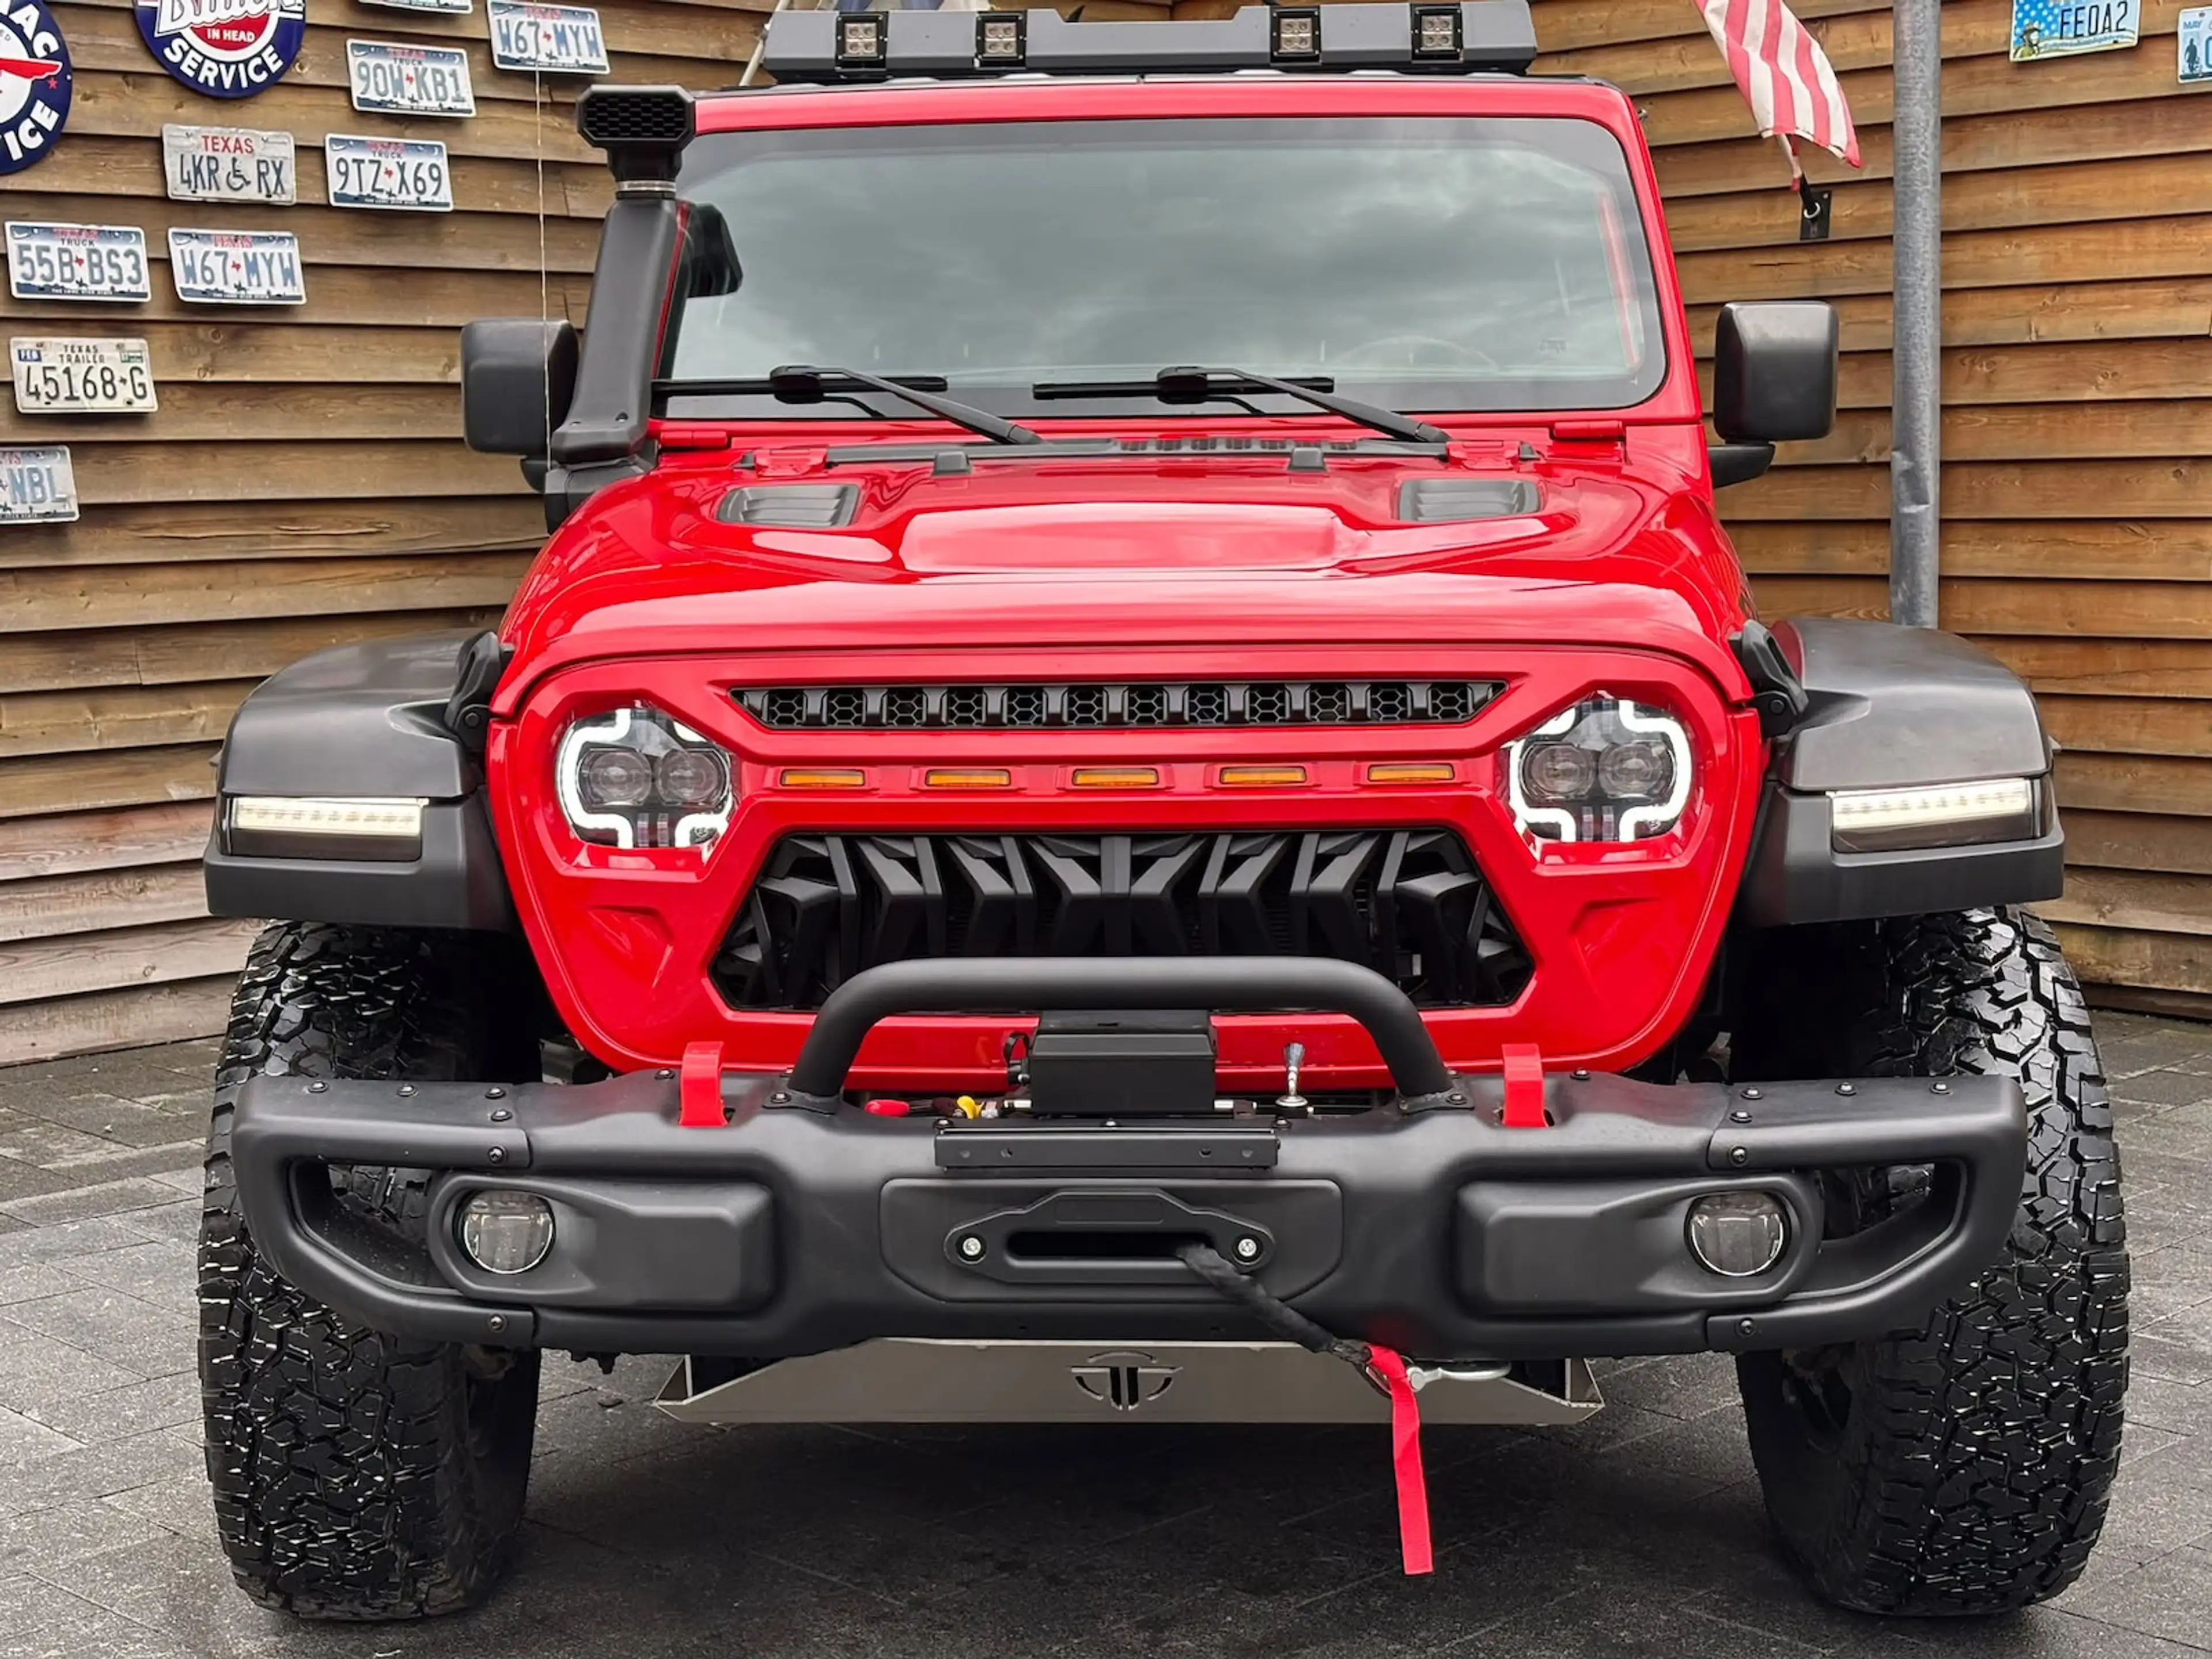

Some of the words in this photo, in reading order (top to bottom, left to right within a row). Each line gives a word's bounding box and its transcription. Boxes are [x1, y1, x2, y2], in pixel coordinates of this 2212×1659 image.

[207, 28, 219, 39] IN
[223, 30, 255, 43] HEAD
[497, 19, 540, 55] W67
[554, 24, 601, 57] MYW
[163, 38, 283, 89] SERVICE
[394, 58, 423, 66] TRUCK
[414, 67, 466, 102] KB1
[202, 135, 254, 154] TEXAS
[372, 150, 403, 159] TRUCK
[181, 154, 220, 191] 4KR
[257, 159, 286, 195] RX
[336, 157, 384, 193] 9TZ
[396, 161, 442, 196] X69
[60, 238, 95, 247] TRUCK
[17, 244, 75, 283] 55B
[86, 248, 142, 285] BS3
[180, 249, 229, 285] W67
[243, 251, 296, 287] MYW
[59, 354, 105, 363] TRAILER
[63, 344, 98, 353] TEXAS
[26, 365, 117, 401] 45168
[130, 366, 147, 400] G
[7, 466, 68, 505] NBL
